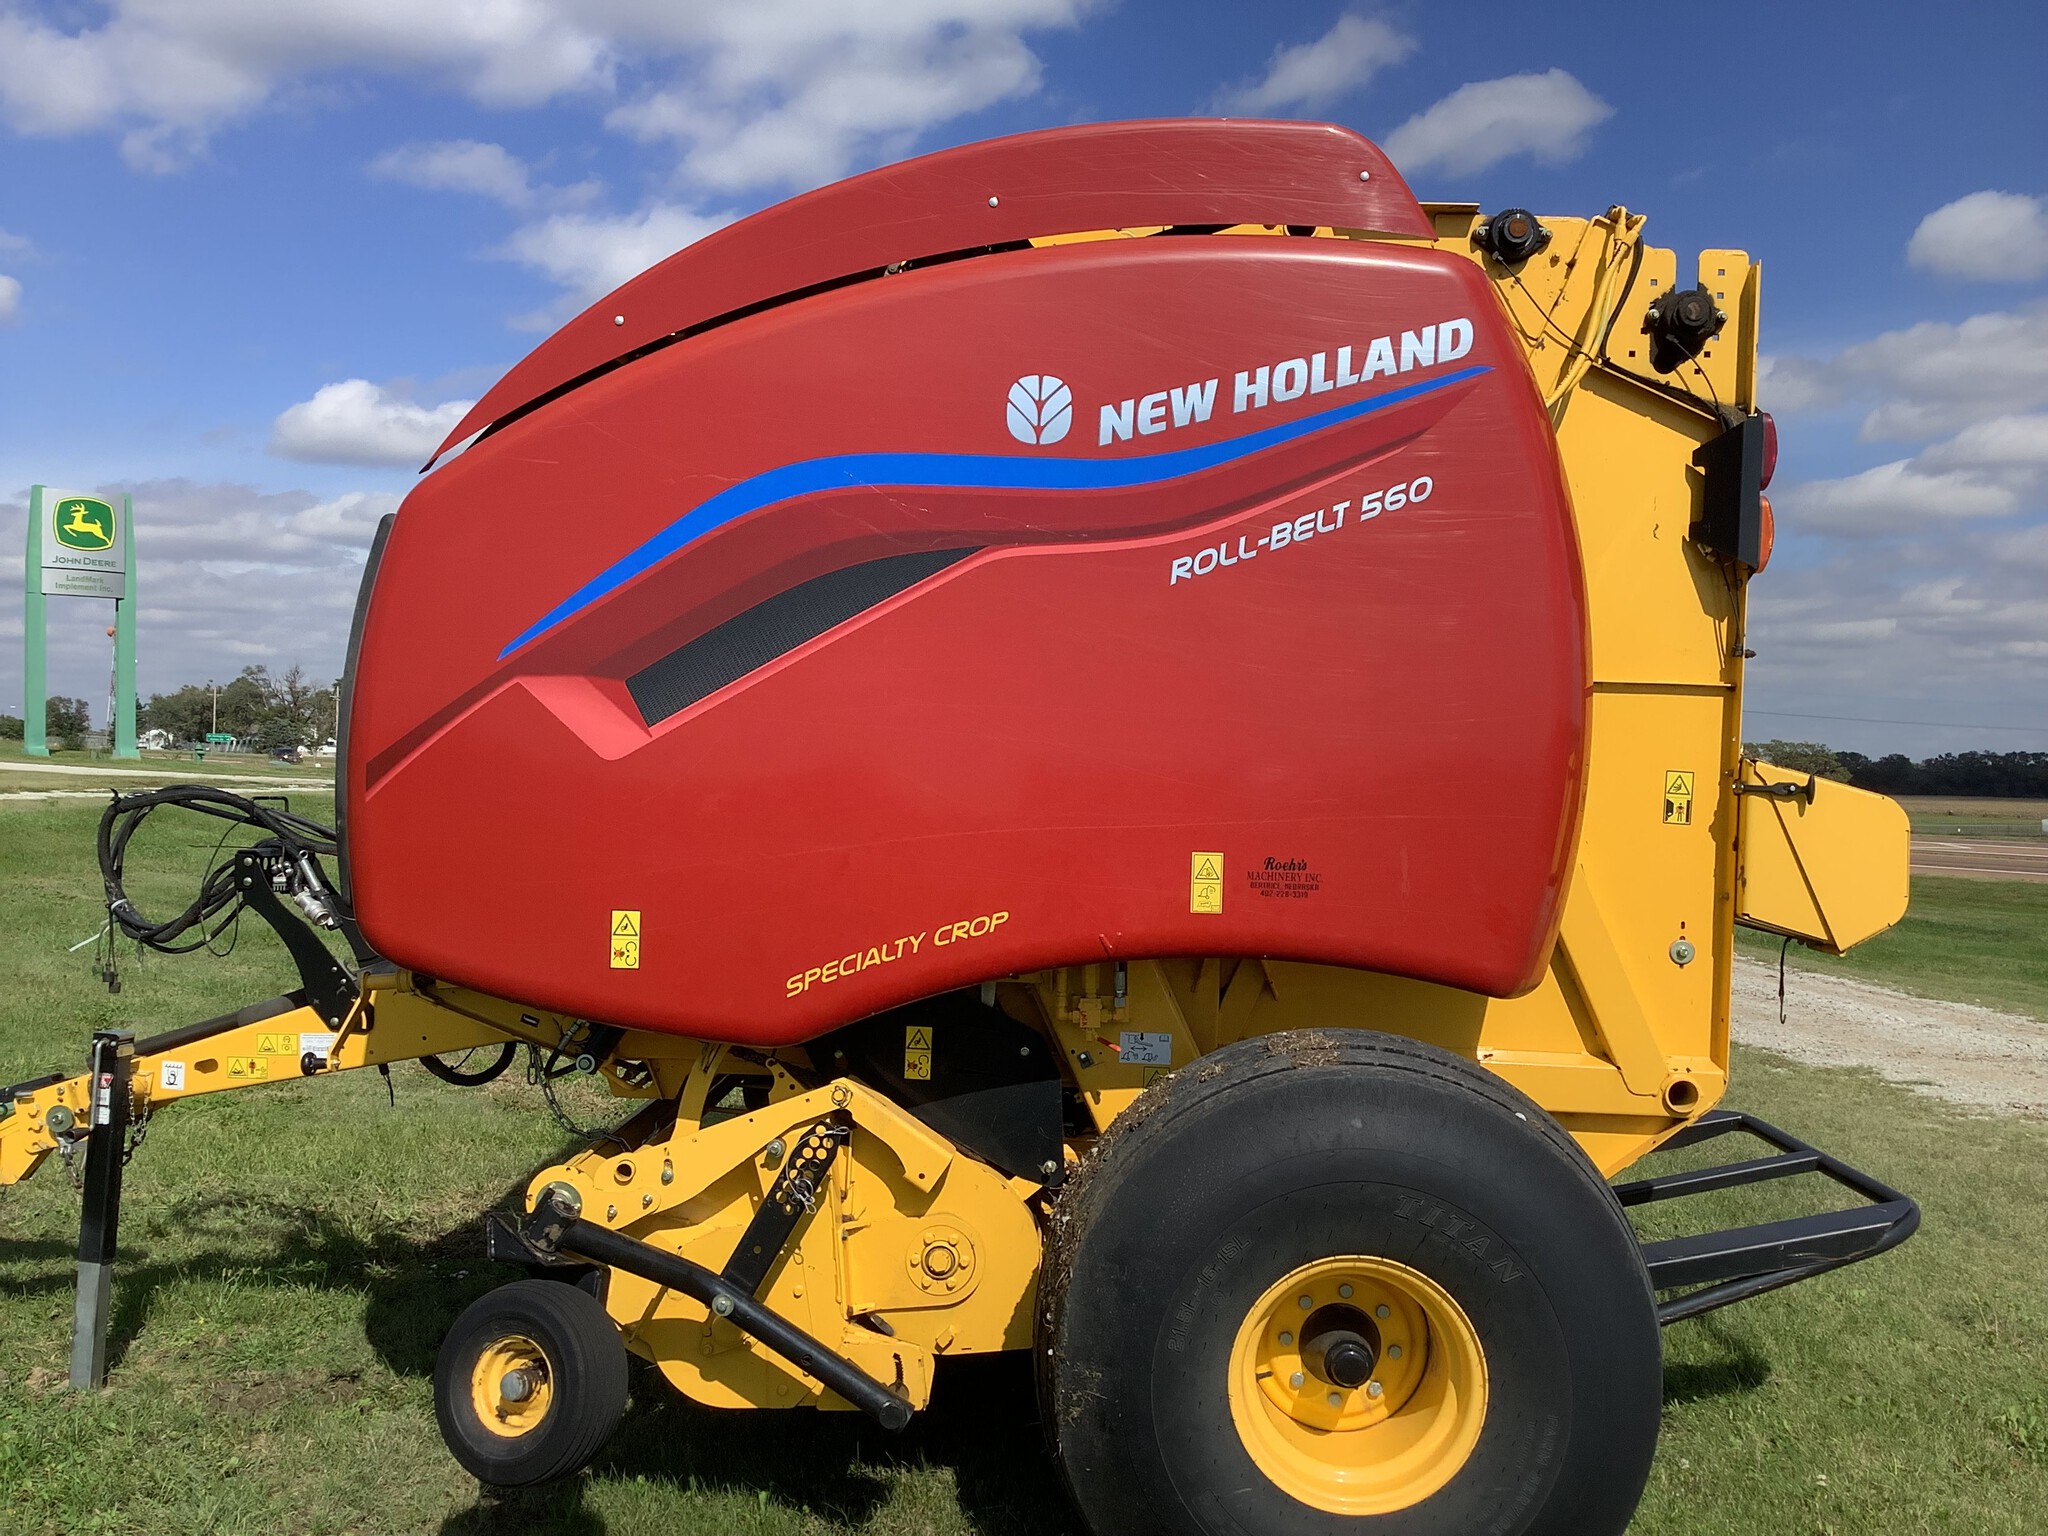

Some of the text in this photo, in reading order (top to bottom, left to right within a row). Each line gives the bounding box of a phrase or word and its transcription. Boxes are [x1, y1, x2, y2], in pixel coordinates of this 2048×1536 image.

[1097, 317, 1475, 447] NEW HOLLAND
[1169, 475, 1434, 586] ROLL-BELT 560
[52, 555, 117, 568] JOHN DEERE
[66, 574, 104, 584] LandMark
[55, 582, 97, 592] Implement
[1264, 857, 1307, 871] Roehr's
[1246, 871, 1303, 882] MACHINERY
[785, 911, 1010, 999] SPECIALTY CROP
[1392, 1192, 1527, 1284] TITAN
